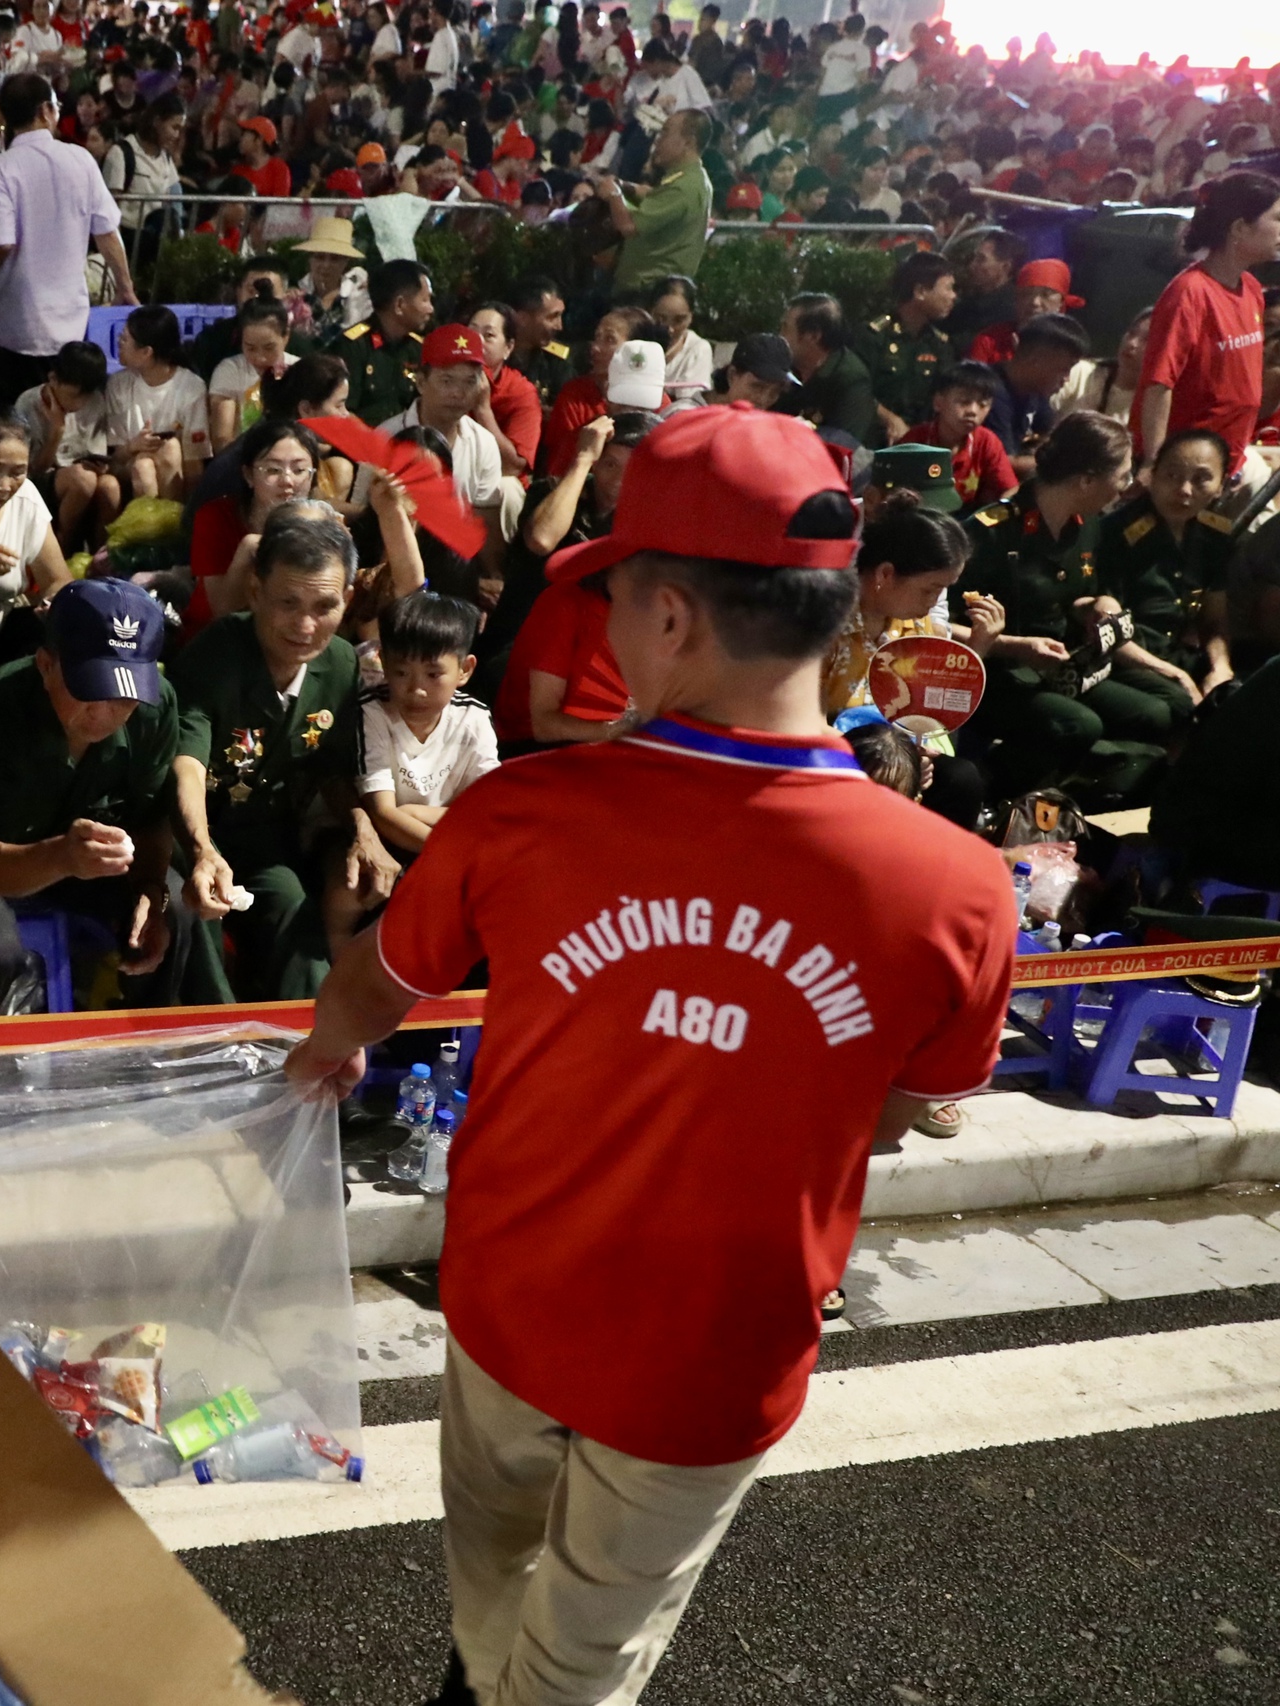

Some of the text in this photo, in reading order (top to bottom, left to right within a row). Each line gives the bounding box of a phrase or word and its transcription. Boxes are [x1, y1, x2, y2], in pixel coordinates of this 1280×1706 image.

[109, 638, 137, 650] adidas
[945, 653, 969, 670] 80
[540, 896, 875, 1048] PHƯỜNG BA ĐÌNH
[1111, 957, 1147, 973] QUA
[1162, 952, 1224, 970] POLICE
[1228, 949, 1269, 964] LINE.
[642, 989, 749, 1052] A80
